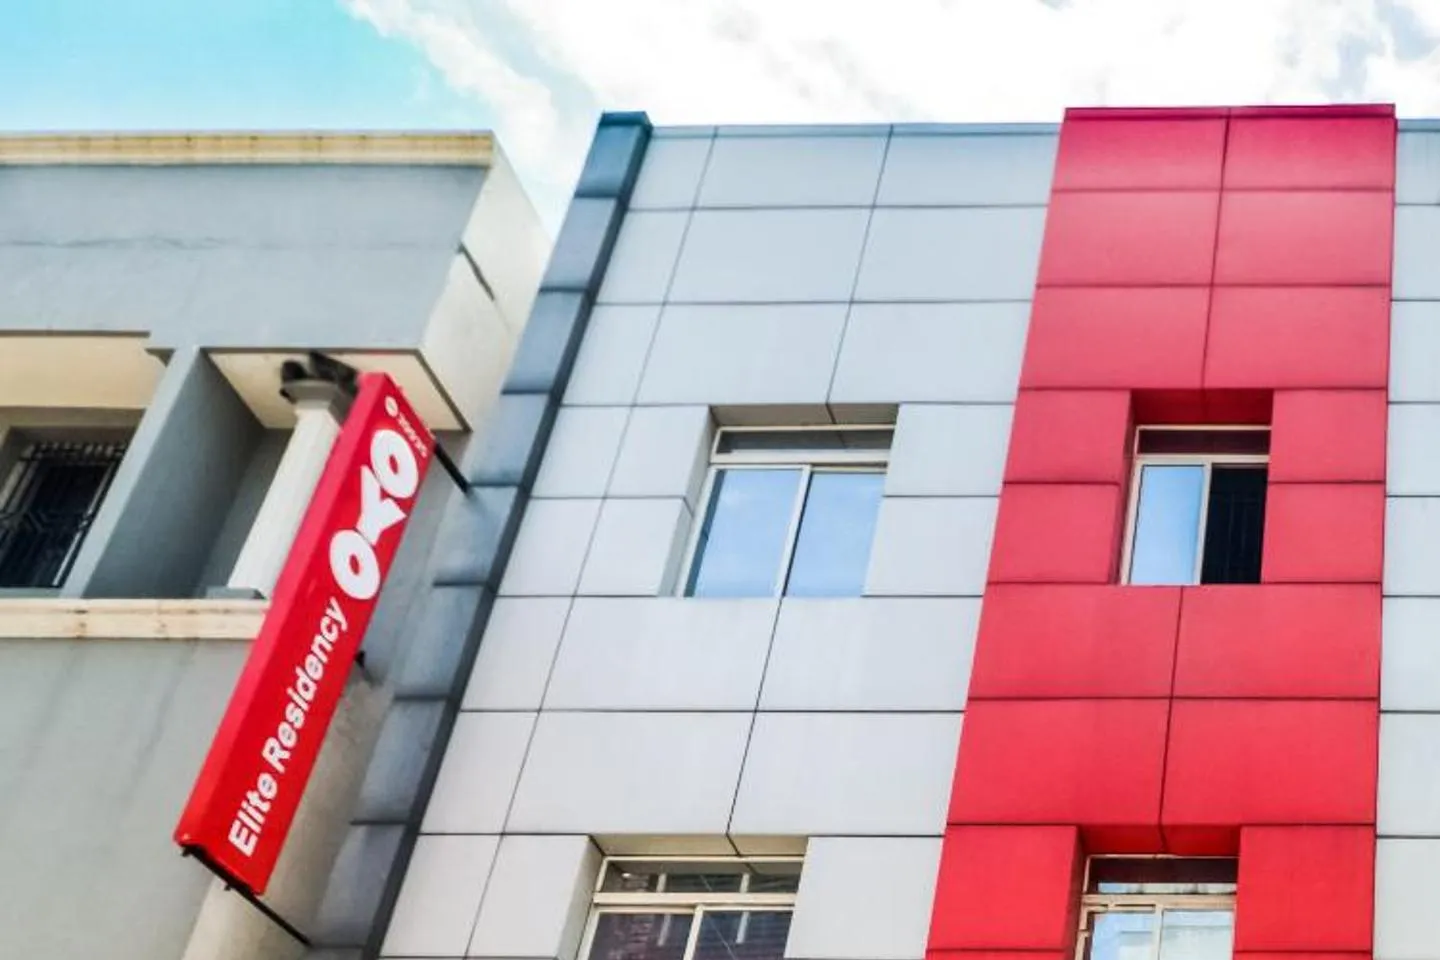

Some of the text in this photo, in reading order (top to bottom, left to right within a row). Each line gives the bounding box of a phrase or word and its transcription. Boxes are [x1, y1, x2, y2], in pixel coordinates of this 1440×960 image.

[329, 429, 419, 600] OYO
[228, 597, 348, 858] Elite Residency
